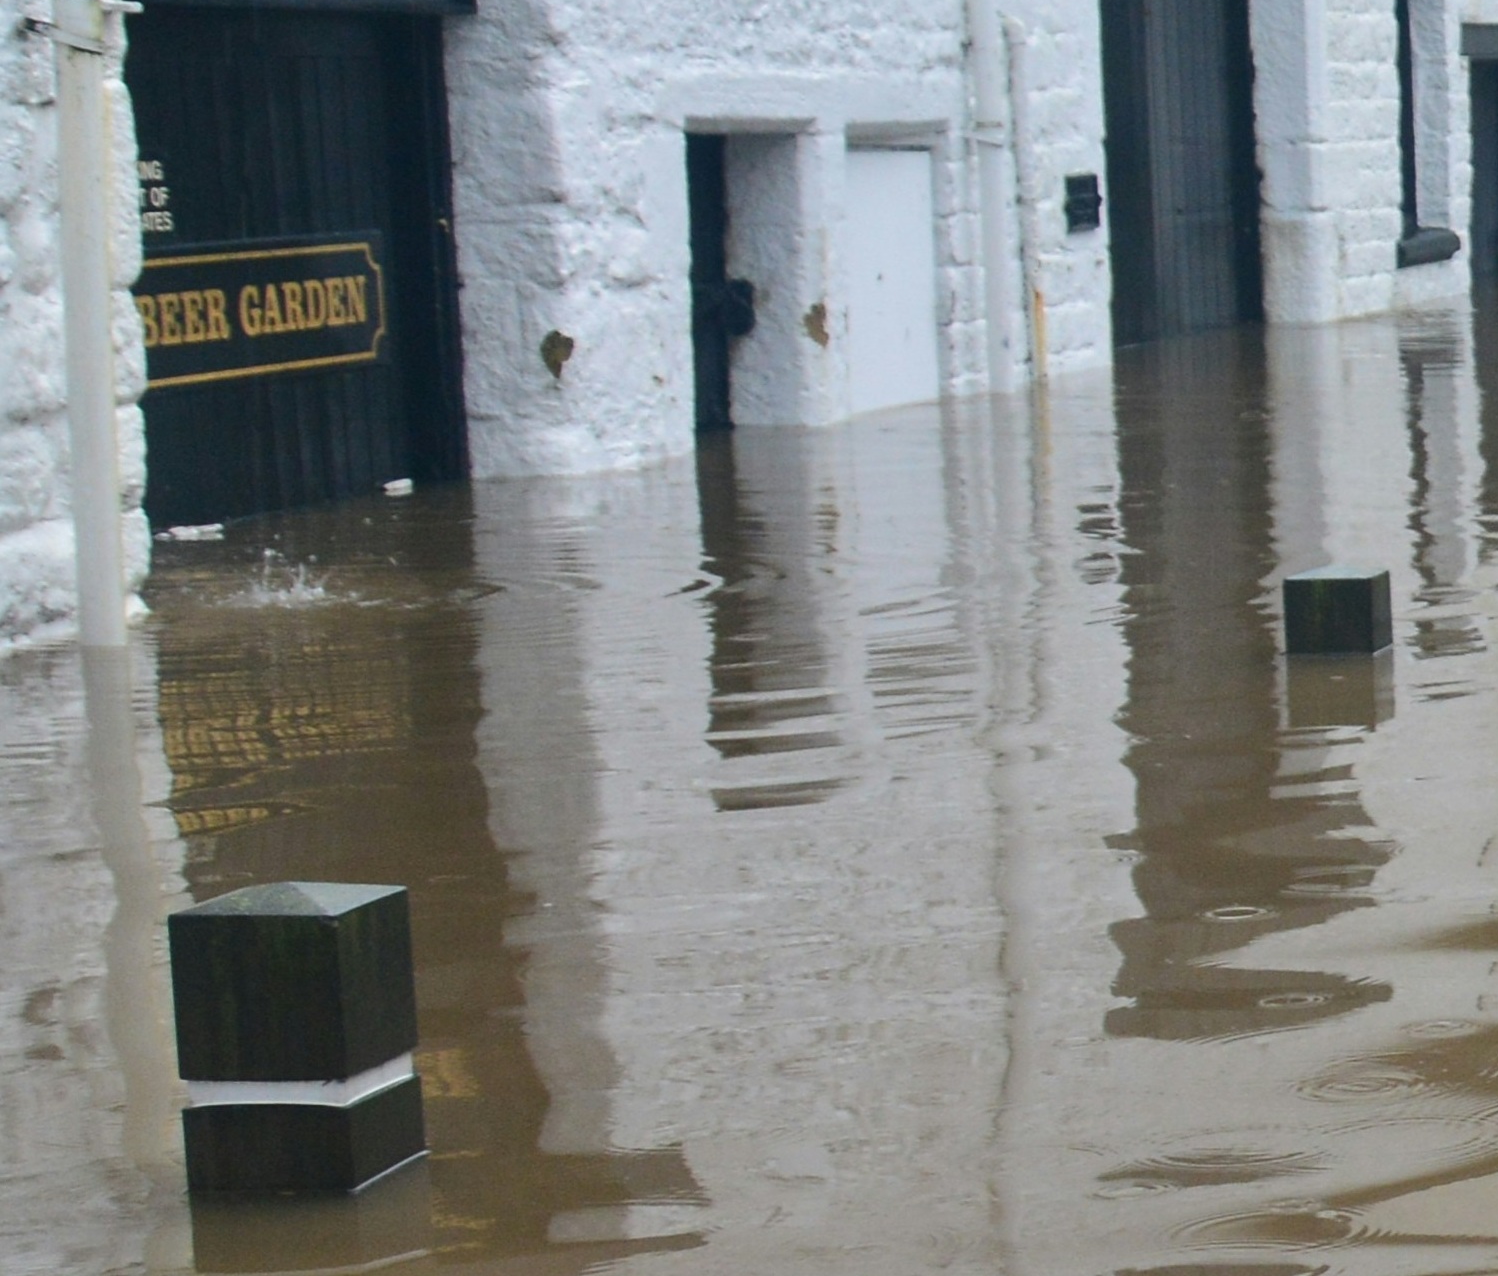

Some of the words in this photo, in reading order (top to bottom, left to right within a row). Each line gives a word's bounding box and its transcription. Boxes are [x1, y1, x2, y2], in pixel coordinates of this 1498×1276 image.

[150, 186, 170, 207] OF
[137, 288, 231, 347] BEER
[239, 275, 367, 336] GARDEN
